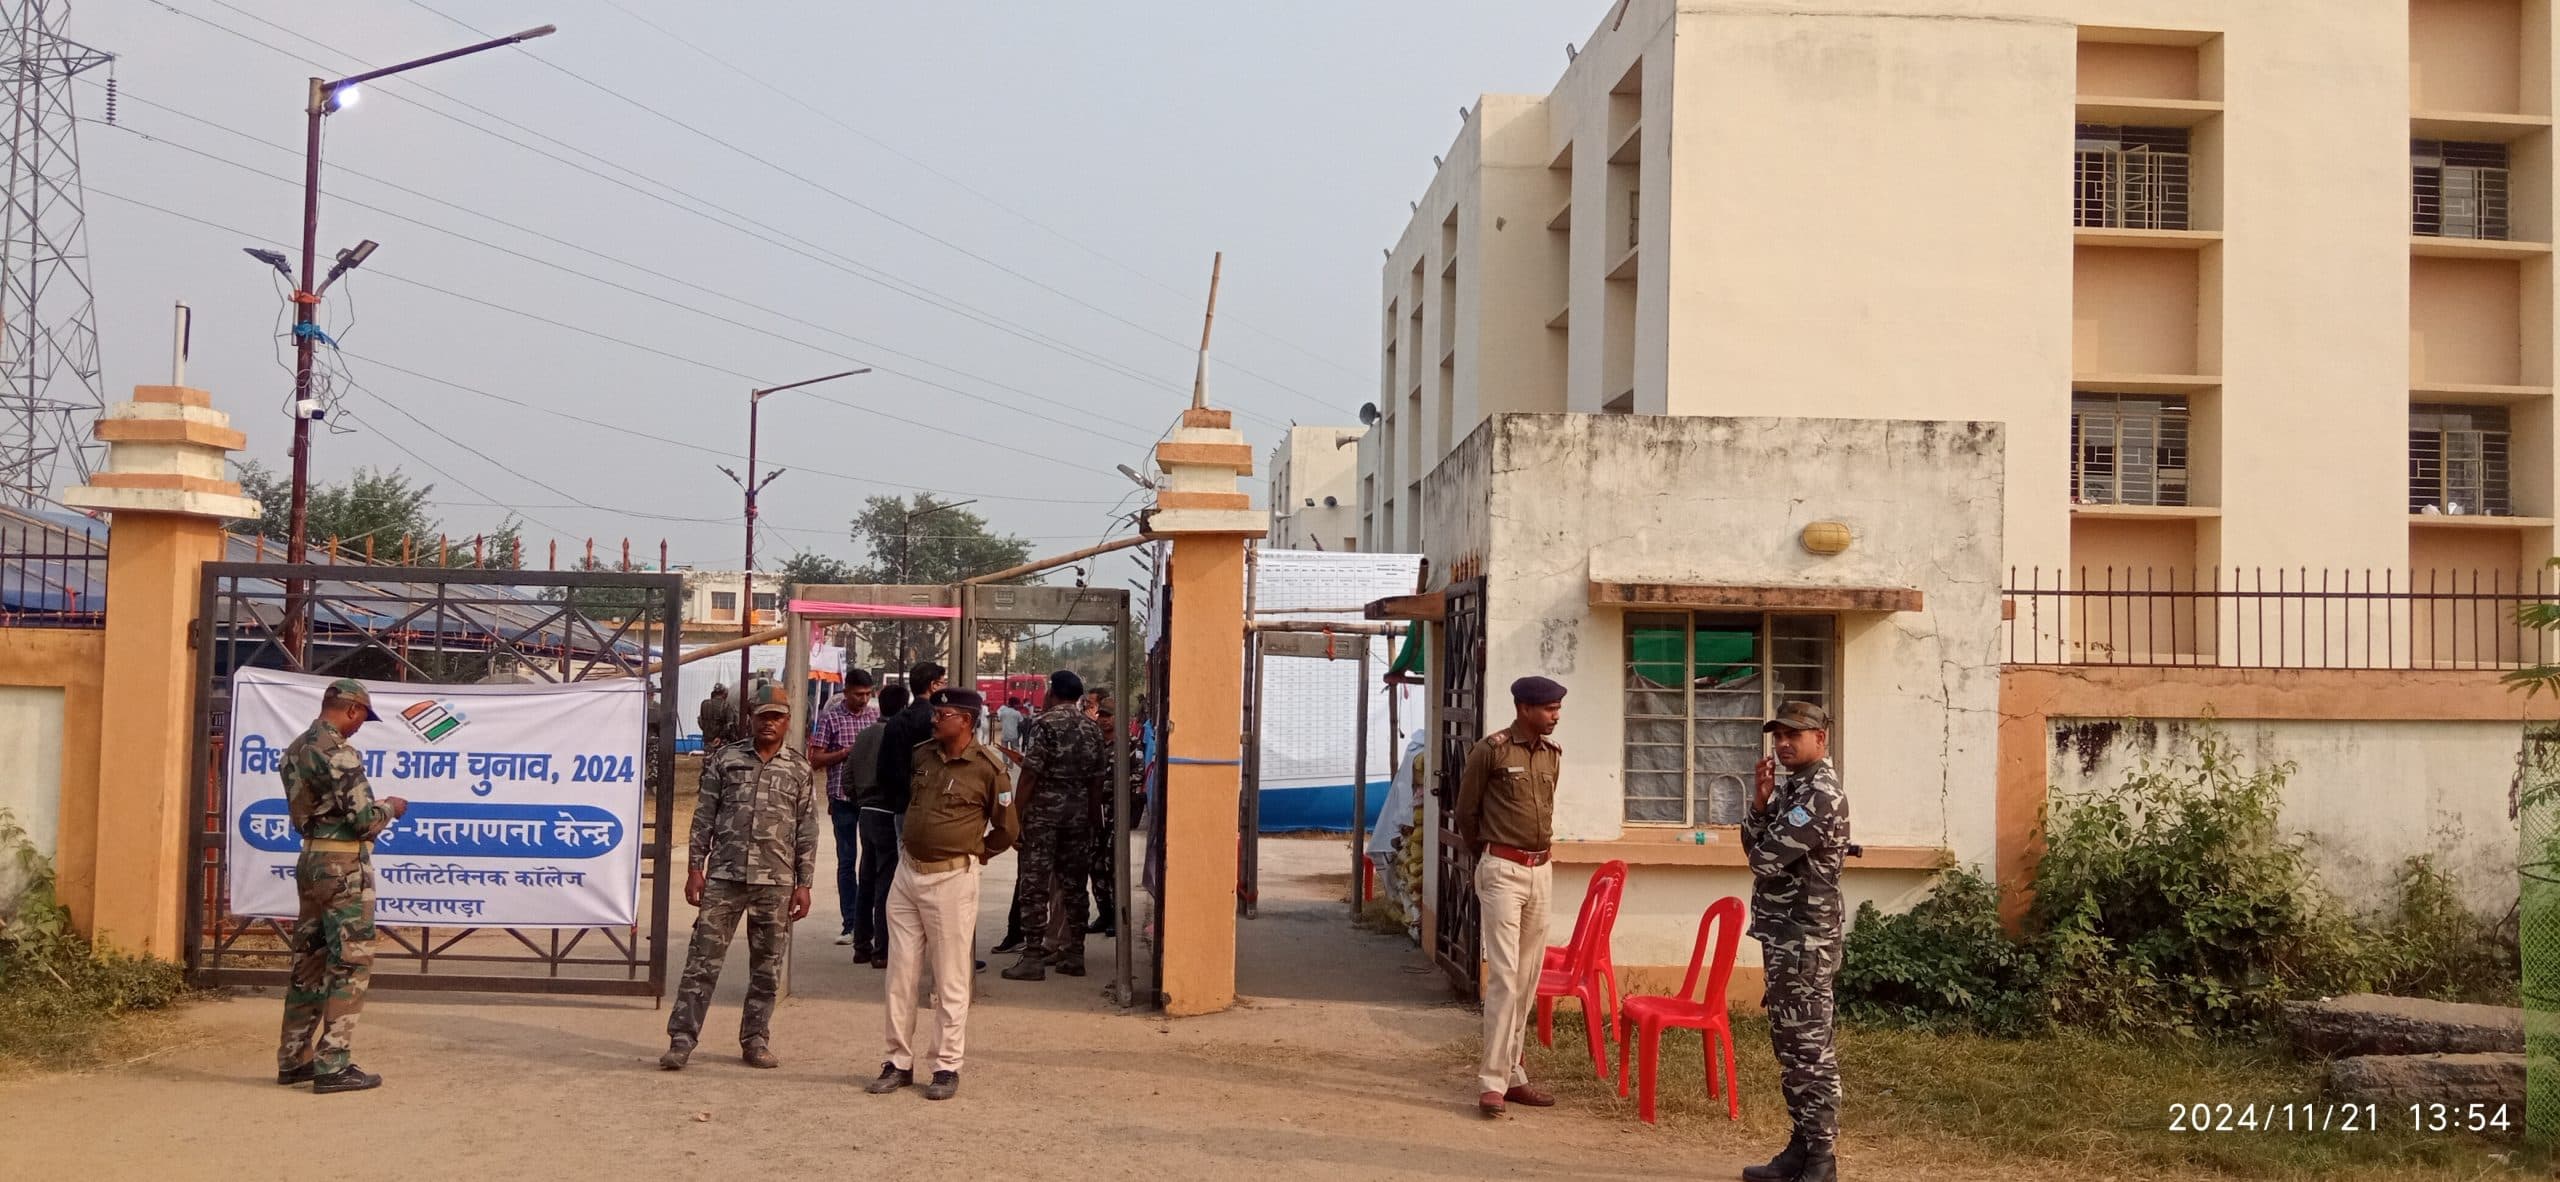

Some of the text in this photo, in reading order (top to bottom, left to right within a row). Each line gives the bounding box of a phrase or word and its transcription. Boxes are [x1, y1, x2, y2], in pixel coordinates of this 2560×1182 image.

[392, 751, 459, 779] आम
[468, 752, 559, 796] चुनाव,
[571, 755, 634, 783] 2024
[553, 810, 616, 847] केन्द्र
[381, 861, 509, 886] पॉलिटेक्निक
[514, 866, 586, 888] कॉलेज
[374, 897, 485, 918] ाथरचापड़ा
